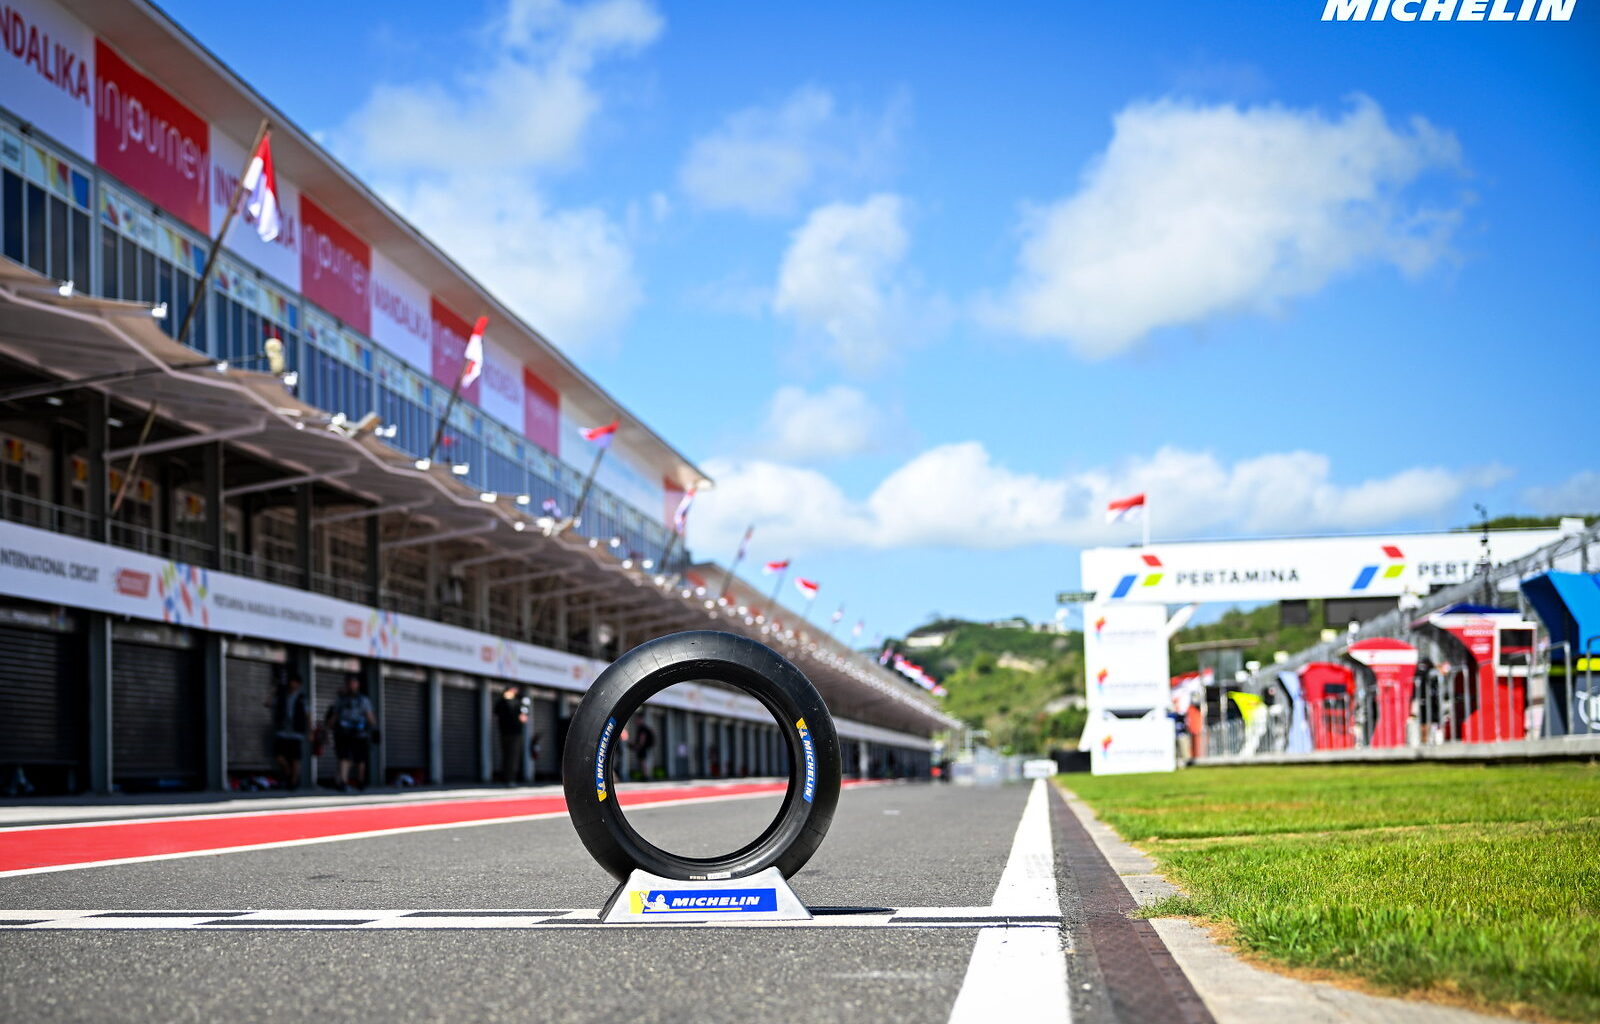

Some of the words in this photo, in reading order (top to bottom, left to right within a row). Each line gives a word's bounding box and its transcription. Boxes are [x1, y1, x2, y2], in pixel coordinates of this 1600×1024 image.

[98, 76, 208, 205] injourney
[1176, 568, 1300, 585] PERTAMINA
[597, 722, 614, 779] MICHELIN
[803, 739, 814, 797] MICHELIN
[671, 896, 761, 907] MICHELIN
